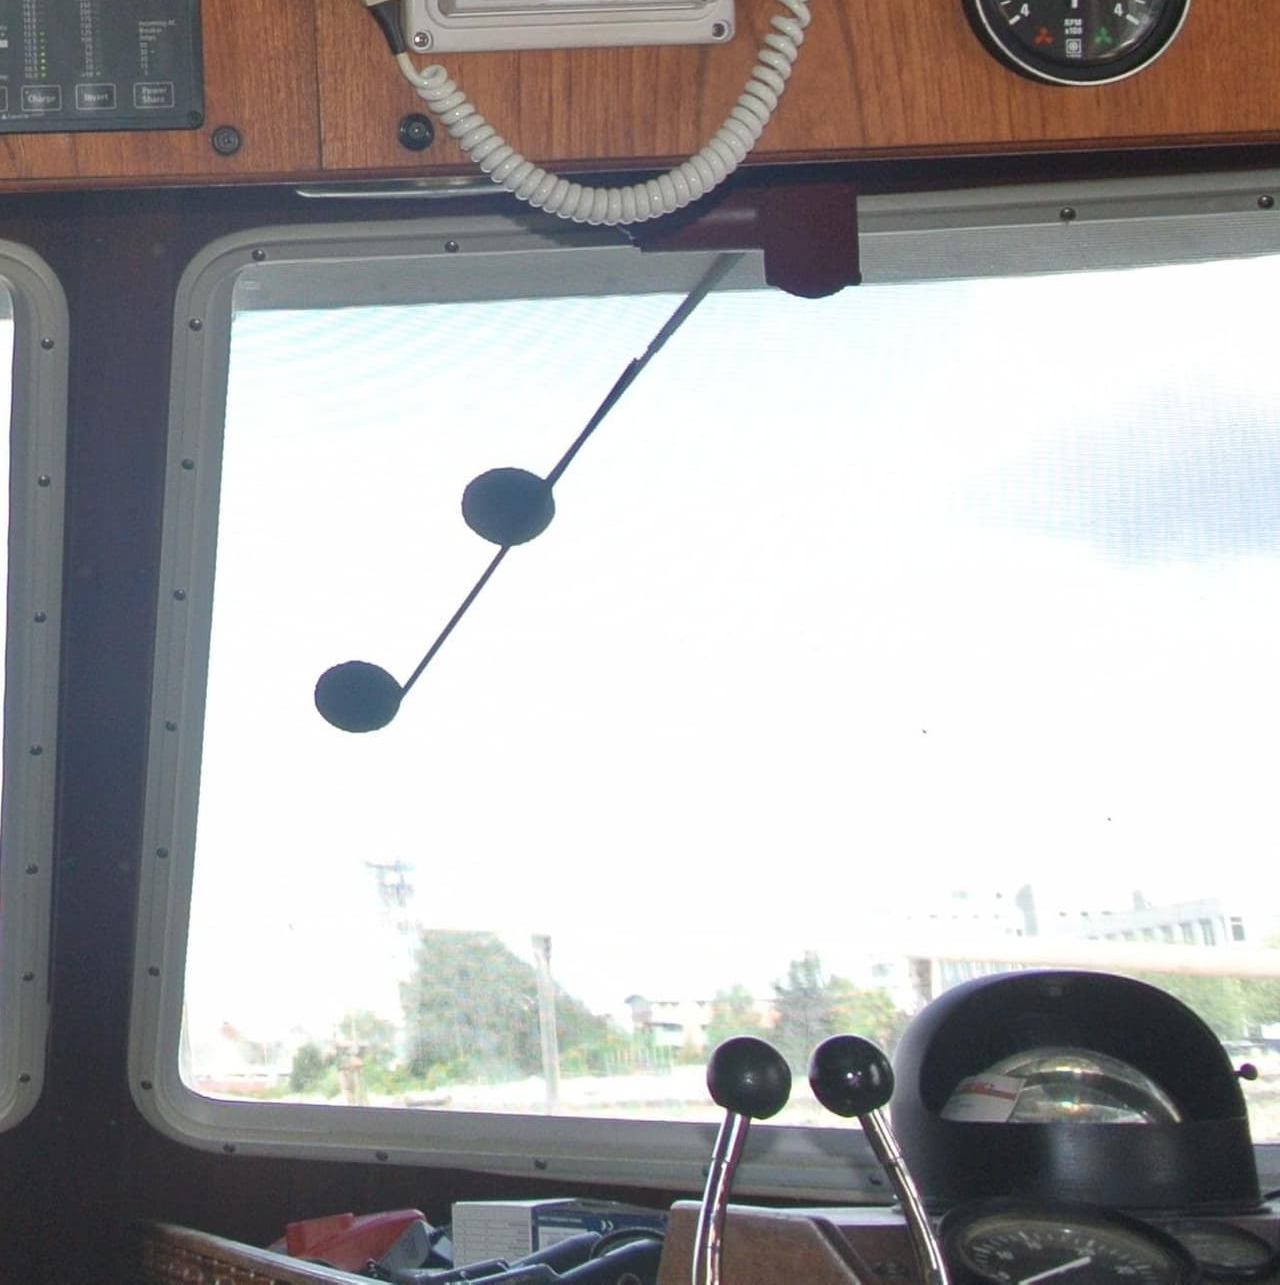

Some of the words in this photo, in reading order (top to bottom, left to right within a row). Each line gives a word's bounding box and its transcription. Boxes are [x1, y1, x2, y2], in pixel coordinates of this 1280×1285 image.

[1020, 3, 1030, 17] 4
[1114, 3, 1123, 17] 4
[1064, 18, 1082, 26] RPM
